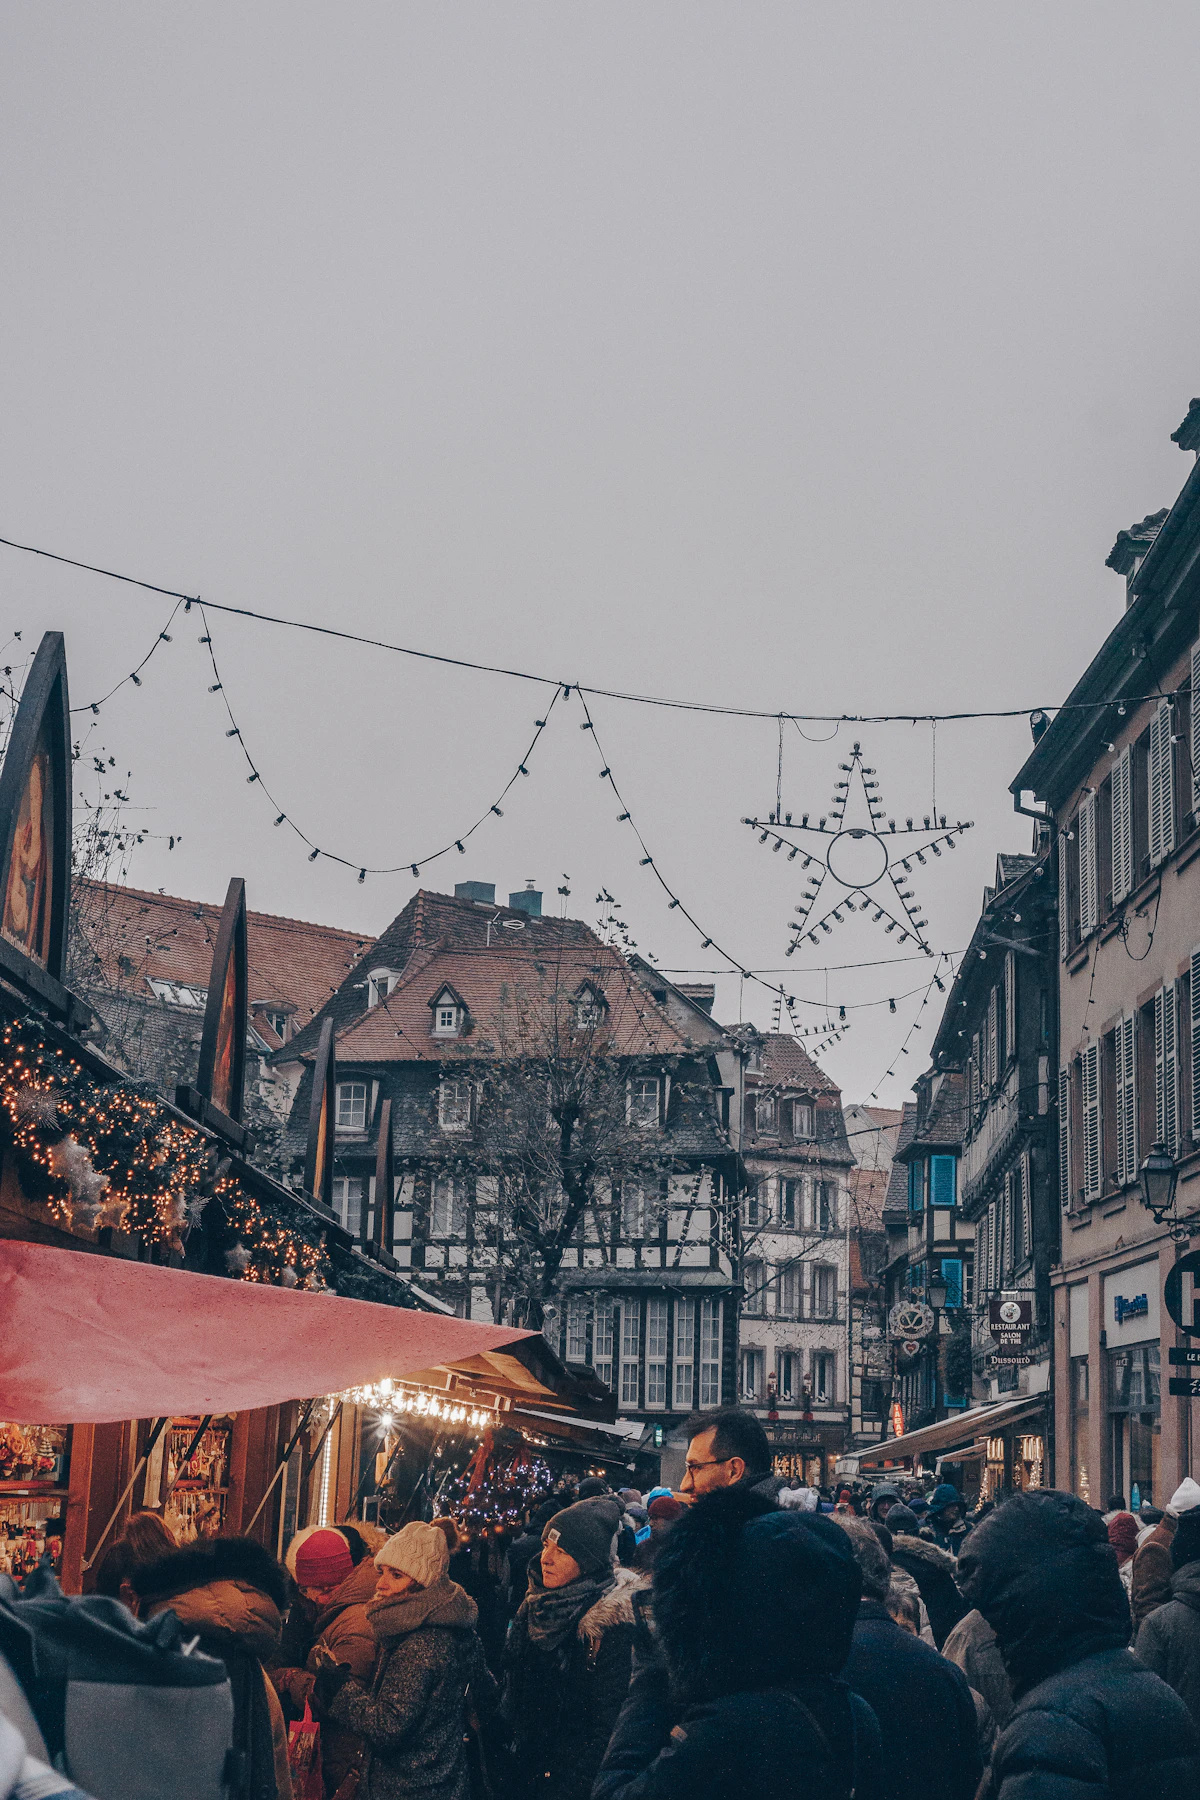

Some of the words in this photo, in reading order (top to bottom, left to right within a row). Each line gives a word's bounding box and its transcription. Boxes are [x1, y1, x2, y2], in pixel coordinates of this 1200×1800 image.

[991, 1356, 1030, 1364] Dussourd
[1187, 1353, 1196, 1361] LE
[894, 1404, 902, 1436] TABAC
